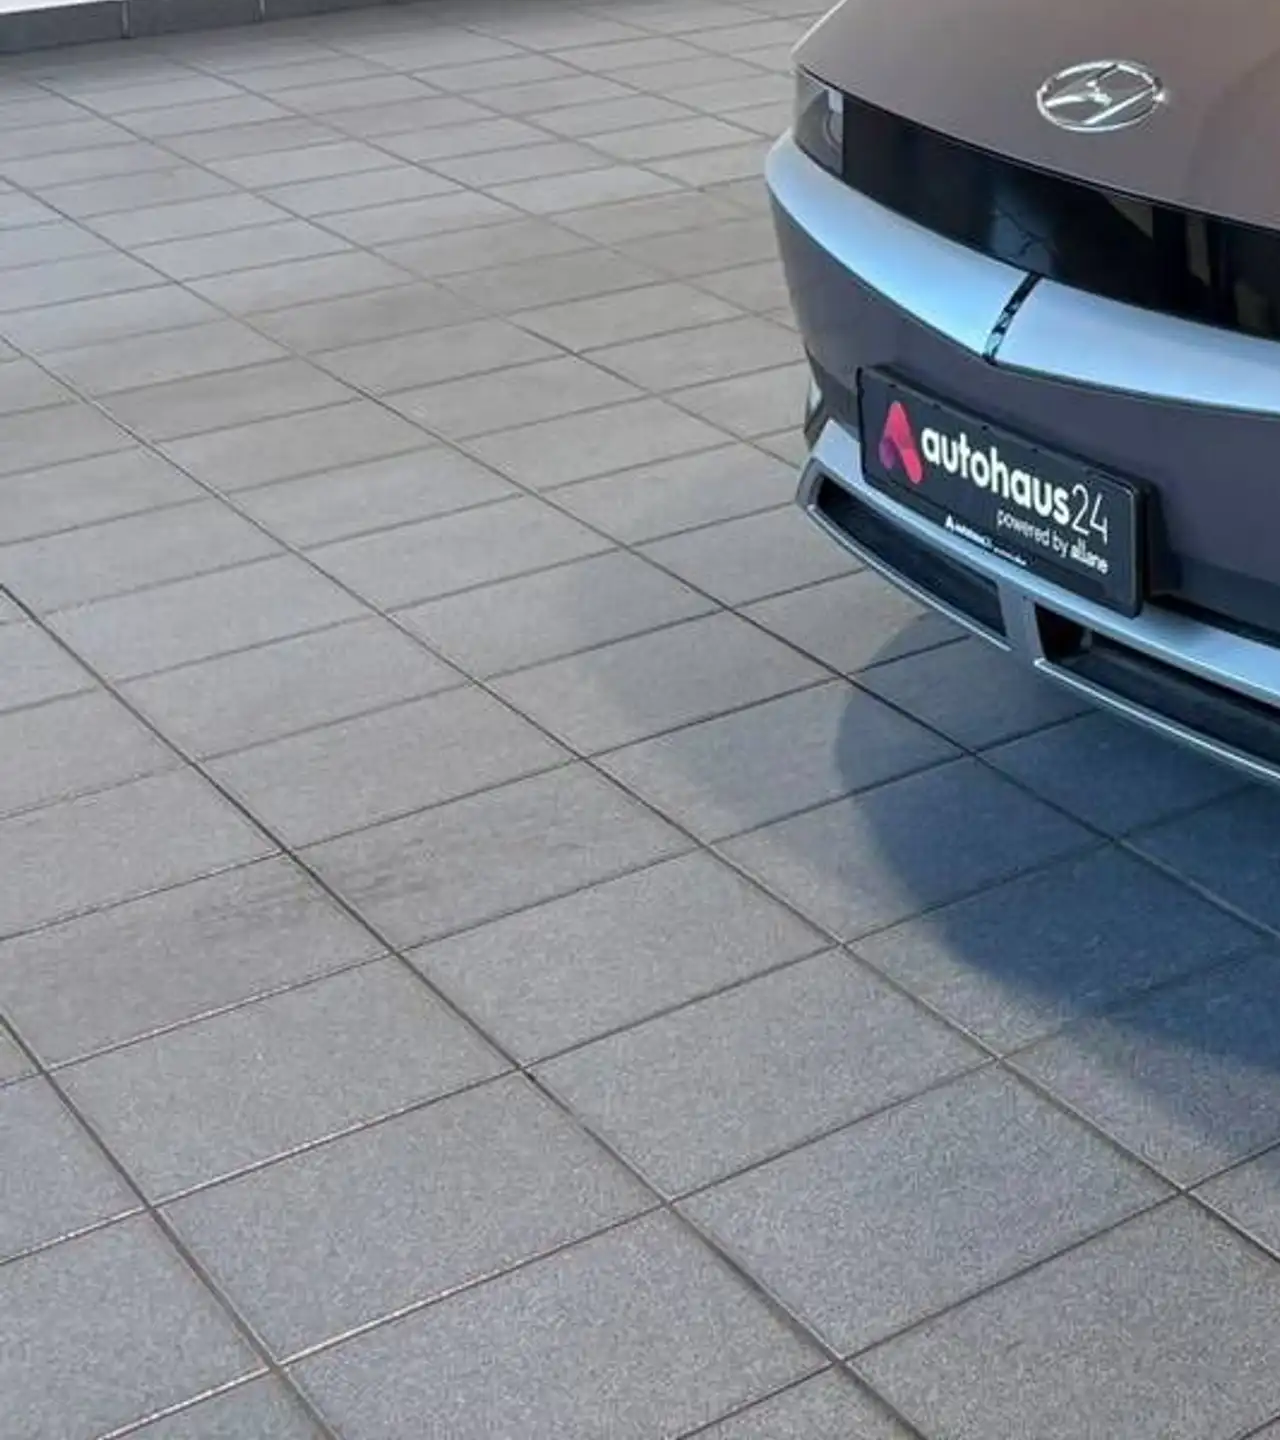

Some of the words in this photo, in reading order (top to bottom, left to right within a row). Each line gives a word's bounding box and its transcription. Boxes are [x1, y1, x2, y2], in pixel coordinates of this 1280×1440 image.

[920, 427, 1109, 545] autohaus24
[996, 508, 1051, 547] powered
[1052, 529, 1070, 559] by
